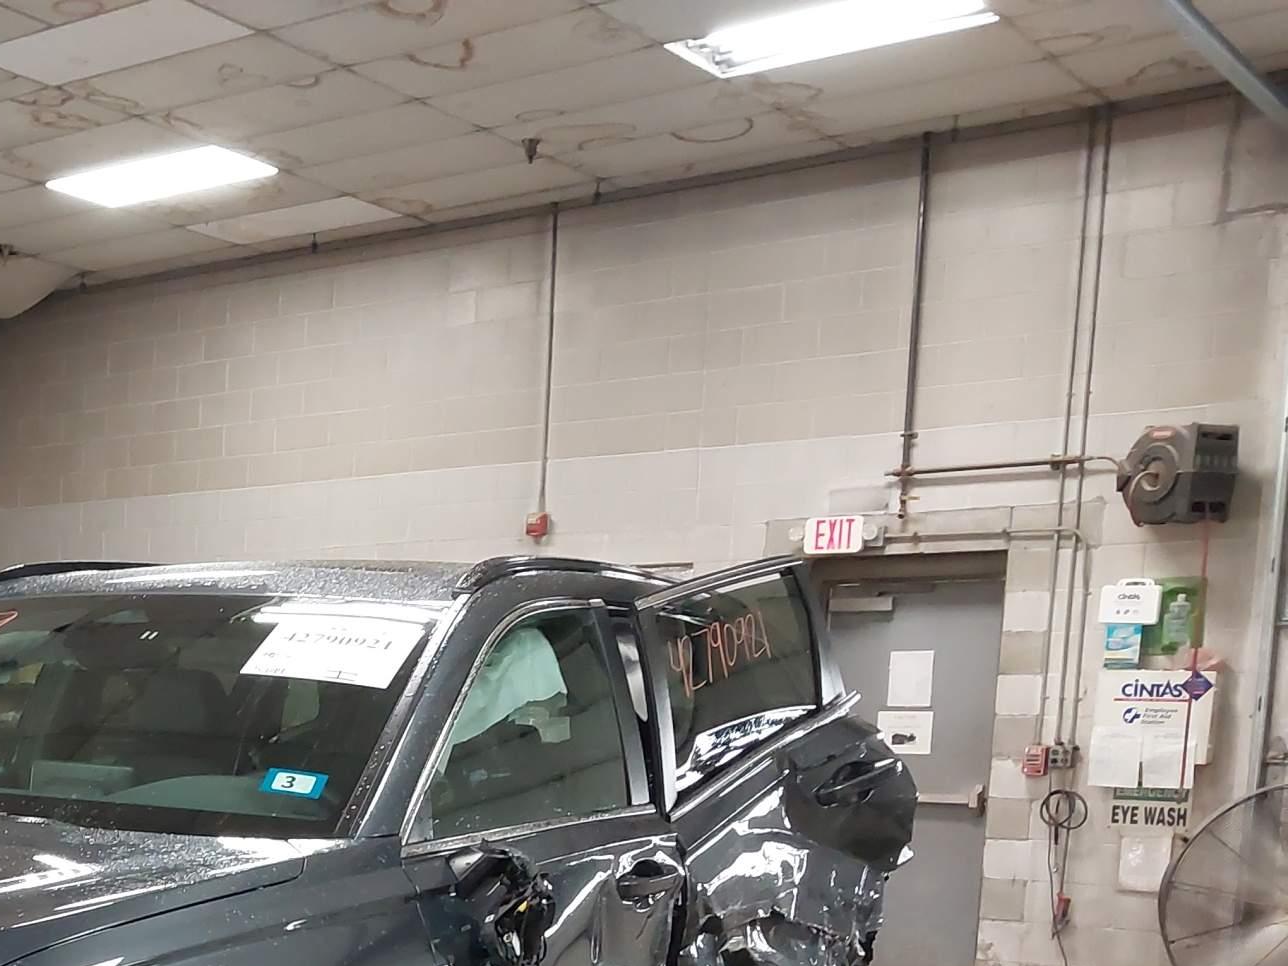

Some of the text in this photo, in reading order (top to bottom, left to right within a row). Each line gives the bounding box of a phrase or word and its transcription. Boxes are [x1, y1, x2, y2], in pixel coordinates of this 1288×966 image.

[815, 518, 855, 550] EXIT
[668, 610, 772, 698] 42790921
[281, 776, 296, 788] 3
[1111, 805, 1187, 827] EYE WASH
